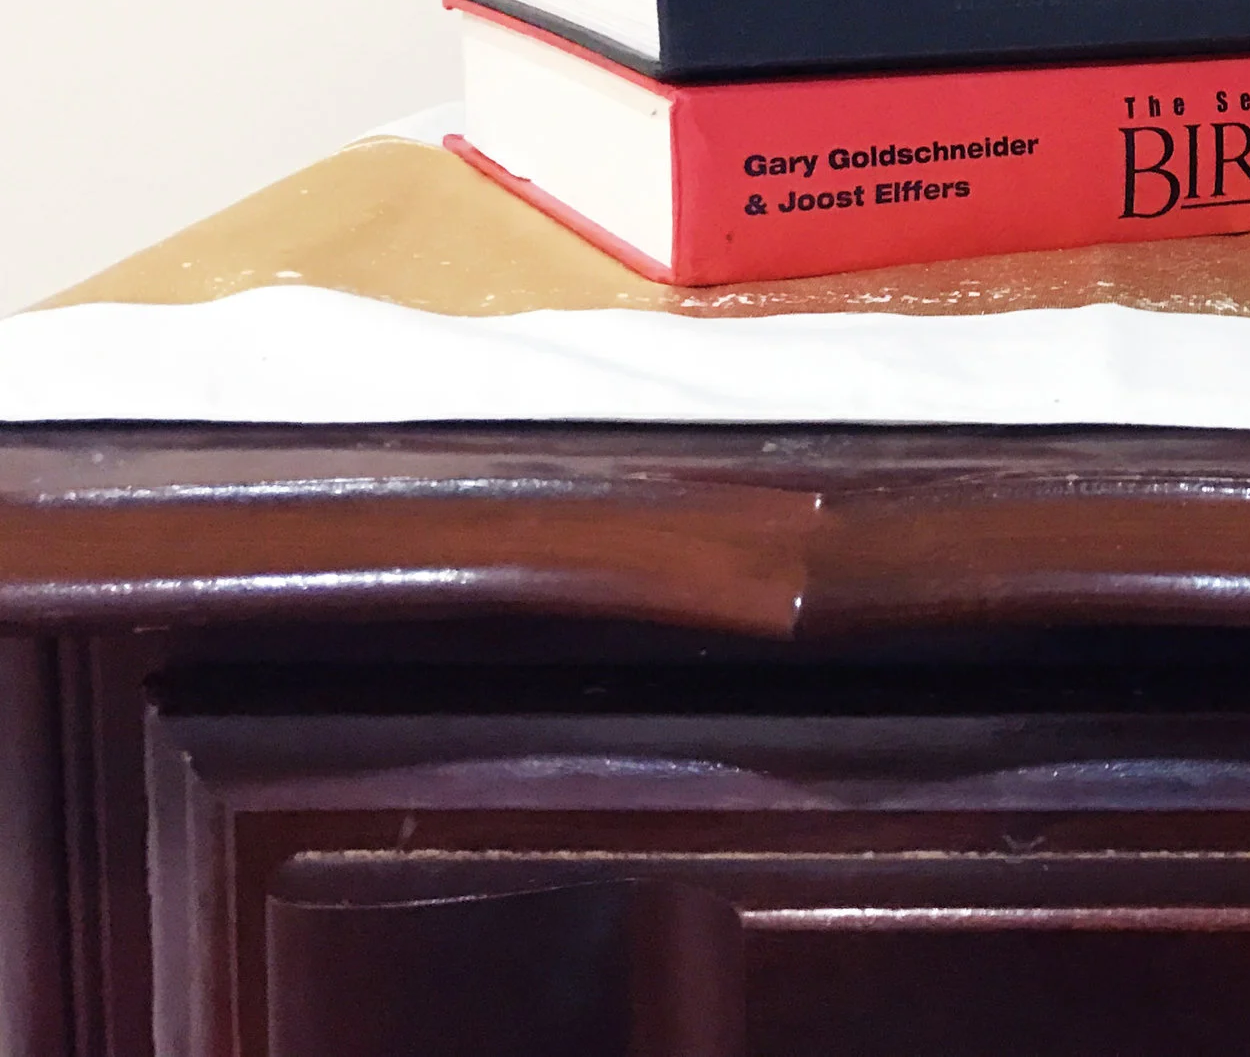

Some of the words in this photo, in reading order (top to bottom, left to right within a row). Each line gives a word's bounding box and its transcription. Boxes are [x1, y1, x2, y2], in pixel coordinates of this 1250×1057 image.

[1124, 94, 1185, 119] The
[744, 152, 818, 178] Gary
[828, 135, 1039, 171] Goldschneider
[744, 193, 769, 216] &
[778, 185, 865, 214] Joost
[875, 178, 971, 205] Elffers
